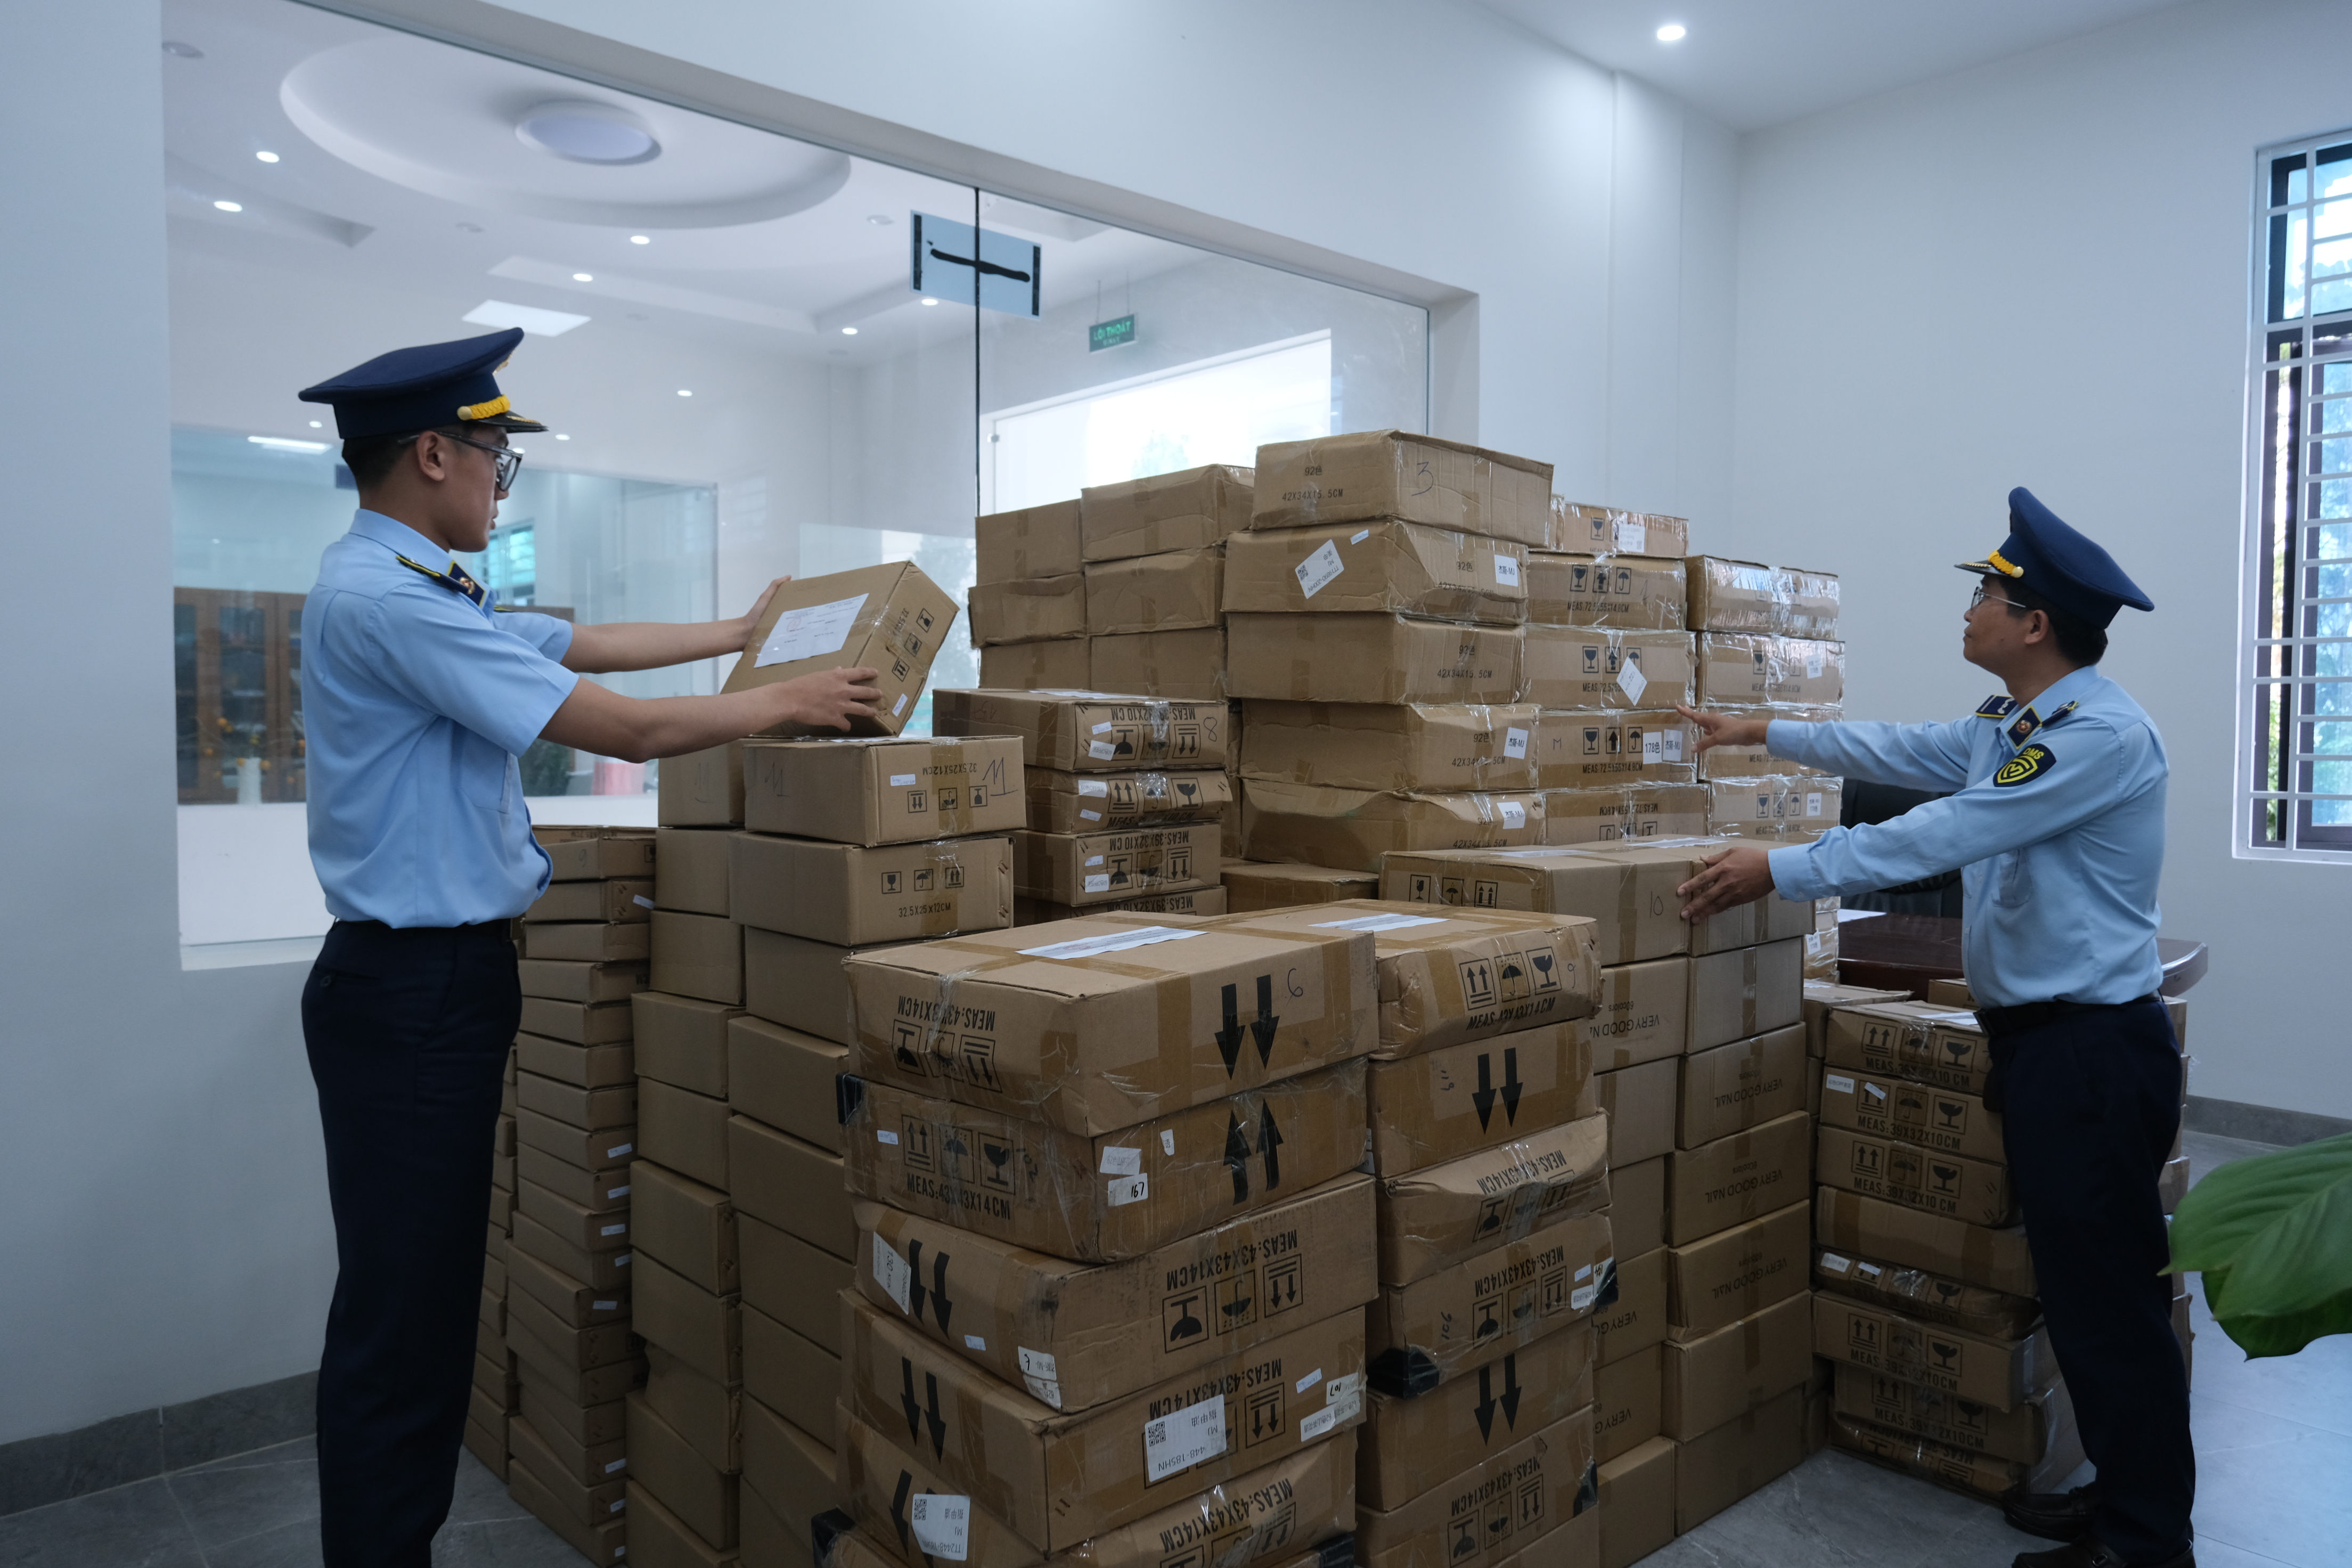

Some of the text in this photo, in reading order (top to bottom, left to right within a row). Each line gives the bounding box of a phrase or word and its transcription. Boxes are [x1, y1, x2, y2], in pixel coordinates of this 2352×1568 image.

[1305, 466, 1322, 476] 92色
[1411, 462, 1434, 496] 3
[1457, 561, 1474, 573] 92色
[1112, 708, 1125, 721] CM
[1474, 733, 1490, 743] 92色
[1645, 742, 1660, 754] 178色
[2024, 747, 2044, 760] DMS
[1109, 838, 1122, 851] CM
[898, 995, 995, 1032] MEAS:433X14CM
[1603, 1019, 1634, 1036] GOOD
[1636, 1015, 1659, 1029] VERY
[1762, 1079, 1783, 1093] VERY
[1953, 1073, 1970, 1087] CM
[1714, 1093, 1733, 1108] NAIL
[1761, 1169, 1783, 1187] VERY
[1131, 1181, 1144, 1198] 167
[1705, 1189, 1725, 1203] NAIL
[1167, 1229, 1298, 1291] MEAS:43X43X14CM
[1611, 1311, 1637, 1330] VERY
[1191, 1409, 1217, 1427] 指甲油
[1604, 1408, 1631, 1429] VERY
[1208, 1425, 1218, 1435] MJ
[954, 1526, 962, 1536] MJ
